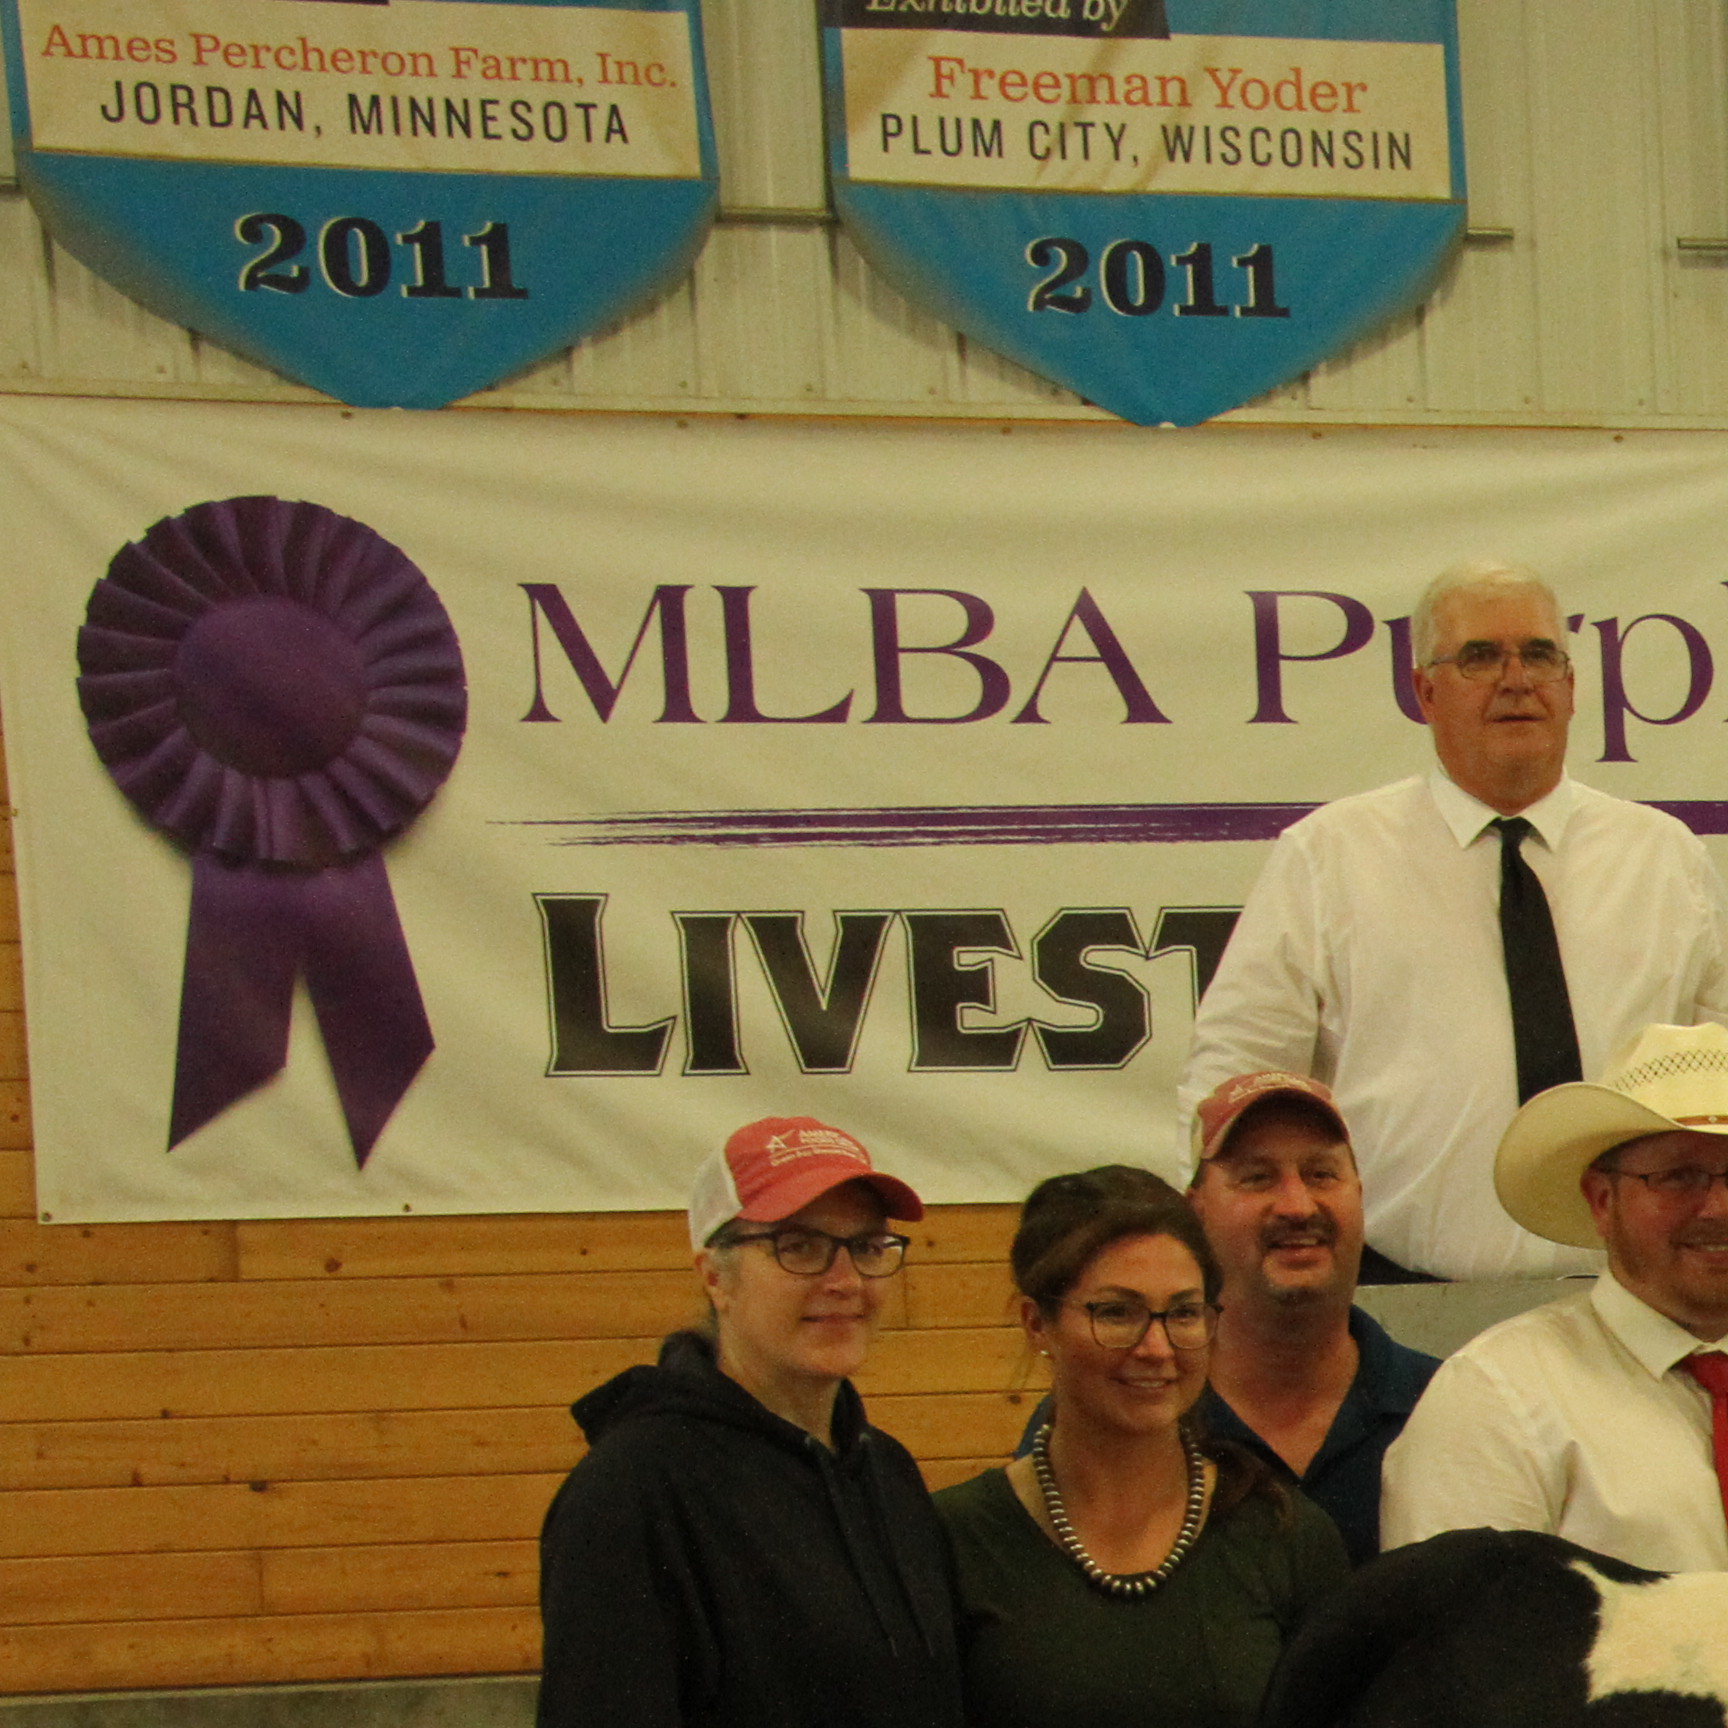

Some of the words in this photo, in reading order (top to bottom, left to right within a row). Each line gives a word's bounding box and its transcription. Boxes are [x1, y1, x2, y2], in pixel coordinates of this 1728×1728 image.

[41, 24, 178, 64] Ames
[191, 32, 436, 78] Percheron
[450, 46, 584, 87] Farm,
[595, 52, 678, 89] Inc.
[927, 55, 1190, 108] Freeman
[1202, 67, 1369, 114] Yoder
[100, 80, 323, 136] JORDAN,
[347, 94, 630, 145] MINNESOTA
[880, 112, 1005, 158] PLUM
[1027, 120, 1141, 168] CITY,
[1160, 124, 1414, 170] WISCONSIN
[232, 212, 530, 300] 2011
[1025, 236, 1290, 319] 2011
[516, 581, 1175, 725] MLBA
[531, 892, 1244, 1078] LIVES
